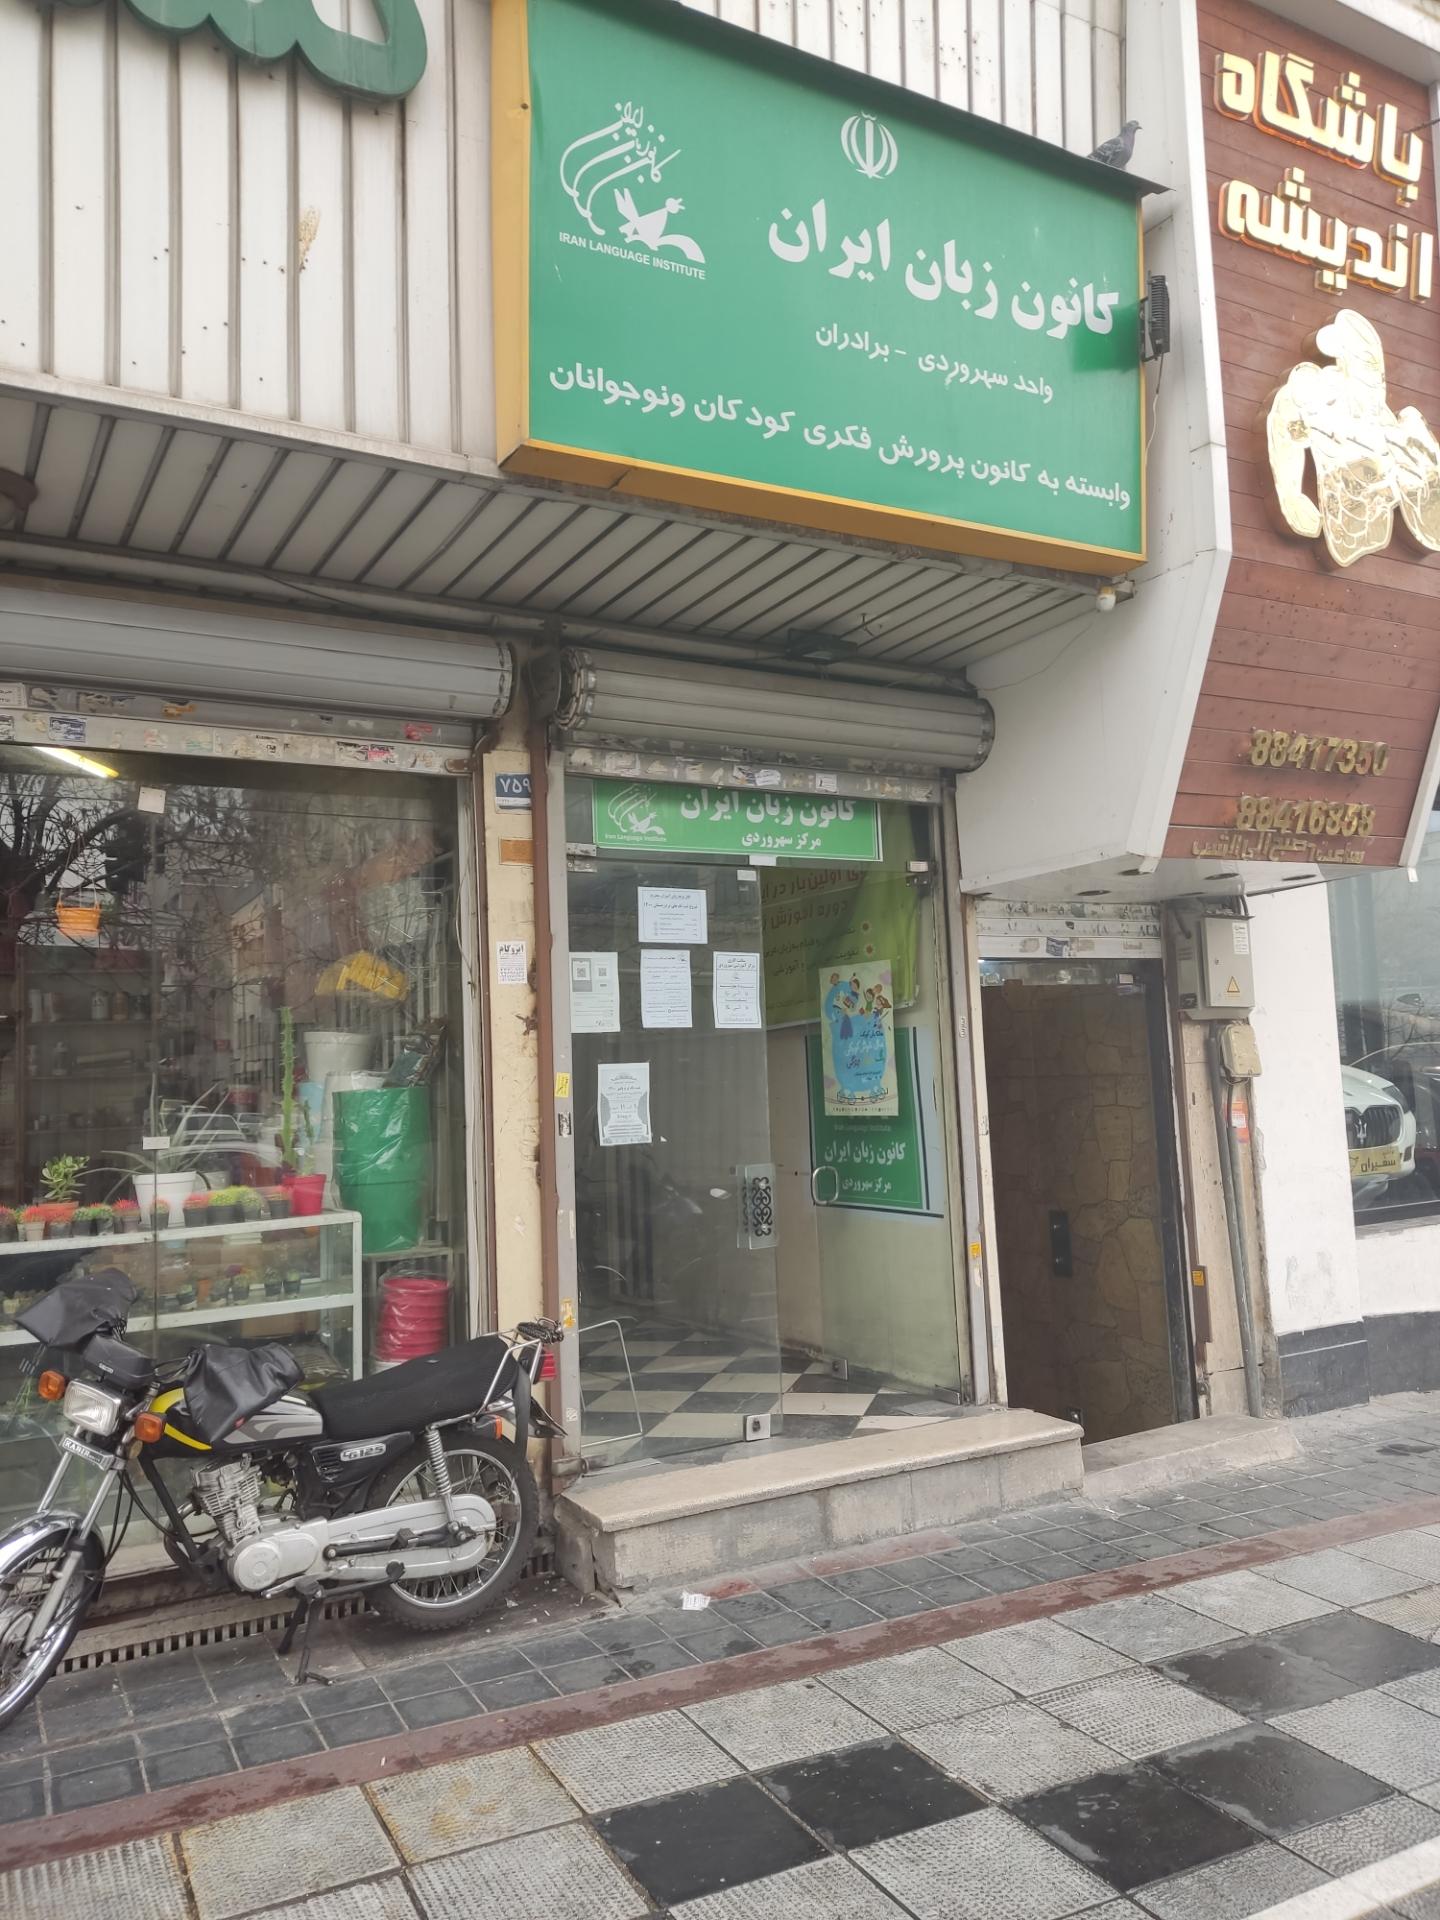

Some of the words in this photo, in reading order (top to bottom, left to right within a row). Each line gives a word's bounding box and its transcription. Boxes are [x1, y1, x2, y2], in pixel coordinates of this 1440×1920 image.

[1214, 51, 1424, 208] باشگاه
[768, 198, 891, 282] ایران
[1218, 167, 1434, 304] اندیشه
[559, 231, 587, 248] IRAN
[589, 239, 650, 265] LANGUAGE
[652, 257, 706, 280] INSTITUTE
[904, 239, 999, 320] زبان
[1011, 277, 1120, 340] کانون
[815, 323, 890, 362] برادران
[918, 353, 1009, 390] سهروردی
[1013, 374, 1053, 404] واحد
[803, 424, 872, 451] فکری
[878, 435, 965, 480] پرورش
[970, 459, 1031, 486] کانون
[1037, 469, 1060, 496] به
[1065, 475, 1131, 511] وابسته
[1250, 729, 1389, 776] 88417350
[499, 777, 532, 794] ۷۵۹
[680, 788, 739, 822] ایران
[746, 793, 794, 826] زبان
[741, 831, 793, 848] سهروردی
[796, 832, 822, 850] مرکز
[824, 1141, 851, 1163] ایران
[853, 1141, 875, 1164] زبان
[877, 1141, 906, 1165] کانون
[842, 1178, 873, 1192] سهروردی
[874, 1177, 892, 1194] مرکز
